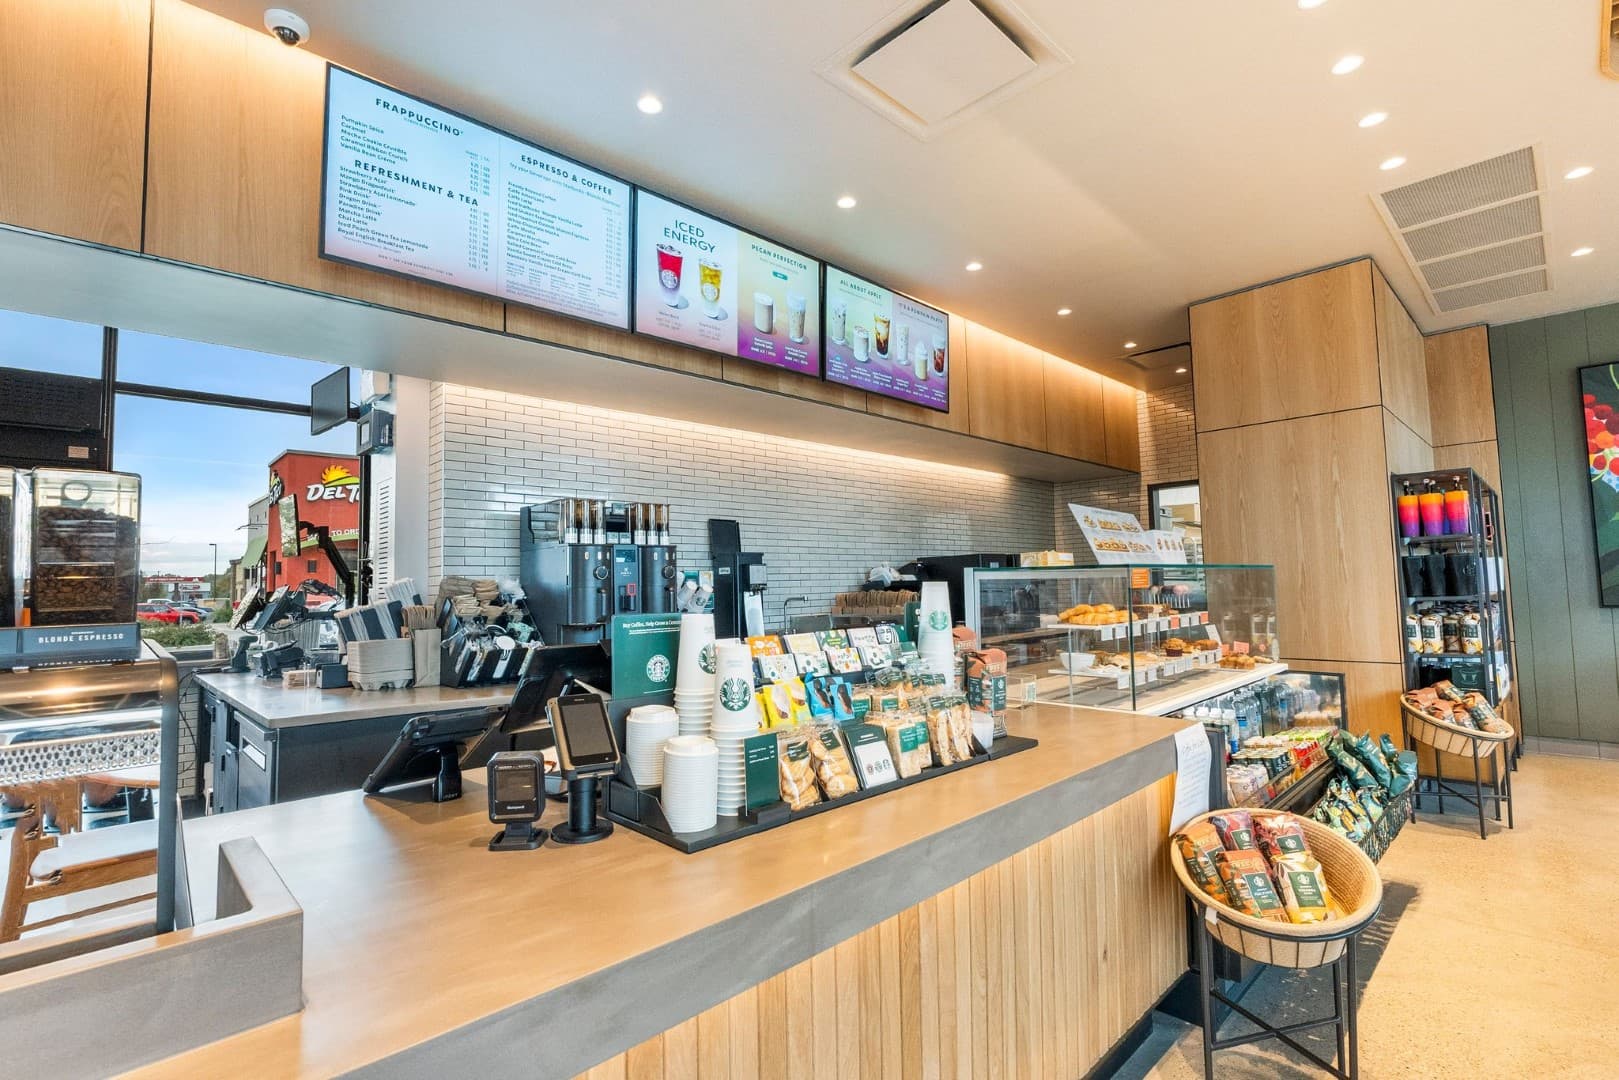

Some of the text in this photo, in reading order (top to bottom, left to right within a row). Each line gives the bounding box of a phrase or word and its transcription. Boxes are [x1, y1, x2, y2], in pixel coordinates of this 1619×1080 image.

[376, 98, 462, 136] FRAPPUCCINO
[341, 122, 366, 134] Caramel
[355, 159, 479, 207] REFRESHMENT & TEA
[521, 154, 613, 196] ESPRESSO & COFFEE
[674, 219, 705, 238] ICED
[663, 227, 716, 254] ENERGY
[752, 244, 772, 257] PECAN
[850, 283, 866, 294] ABOUT
[307, 484, 346, 501] DEL
[38, 636, 74, 644] BLONDE
[78, 633, 124, 642] ESPRESSO
